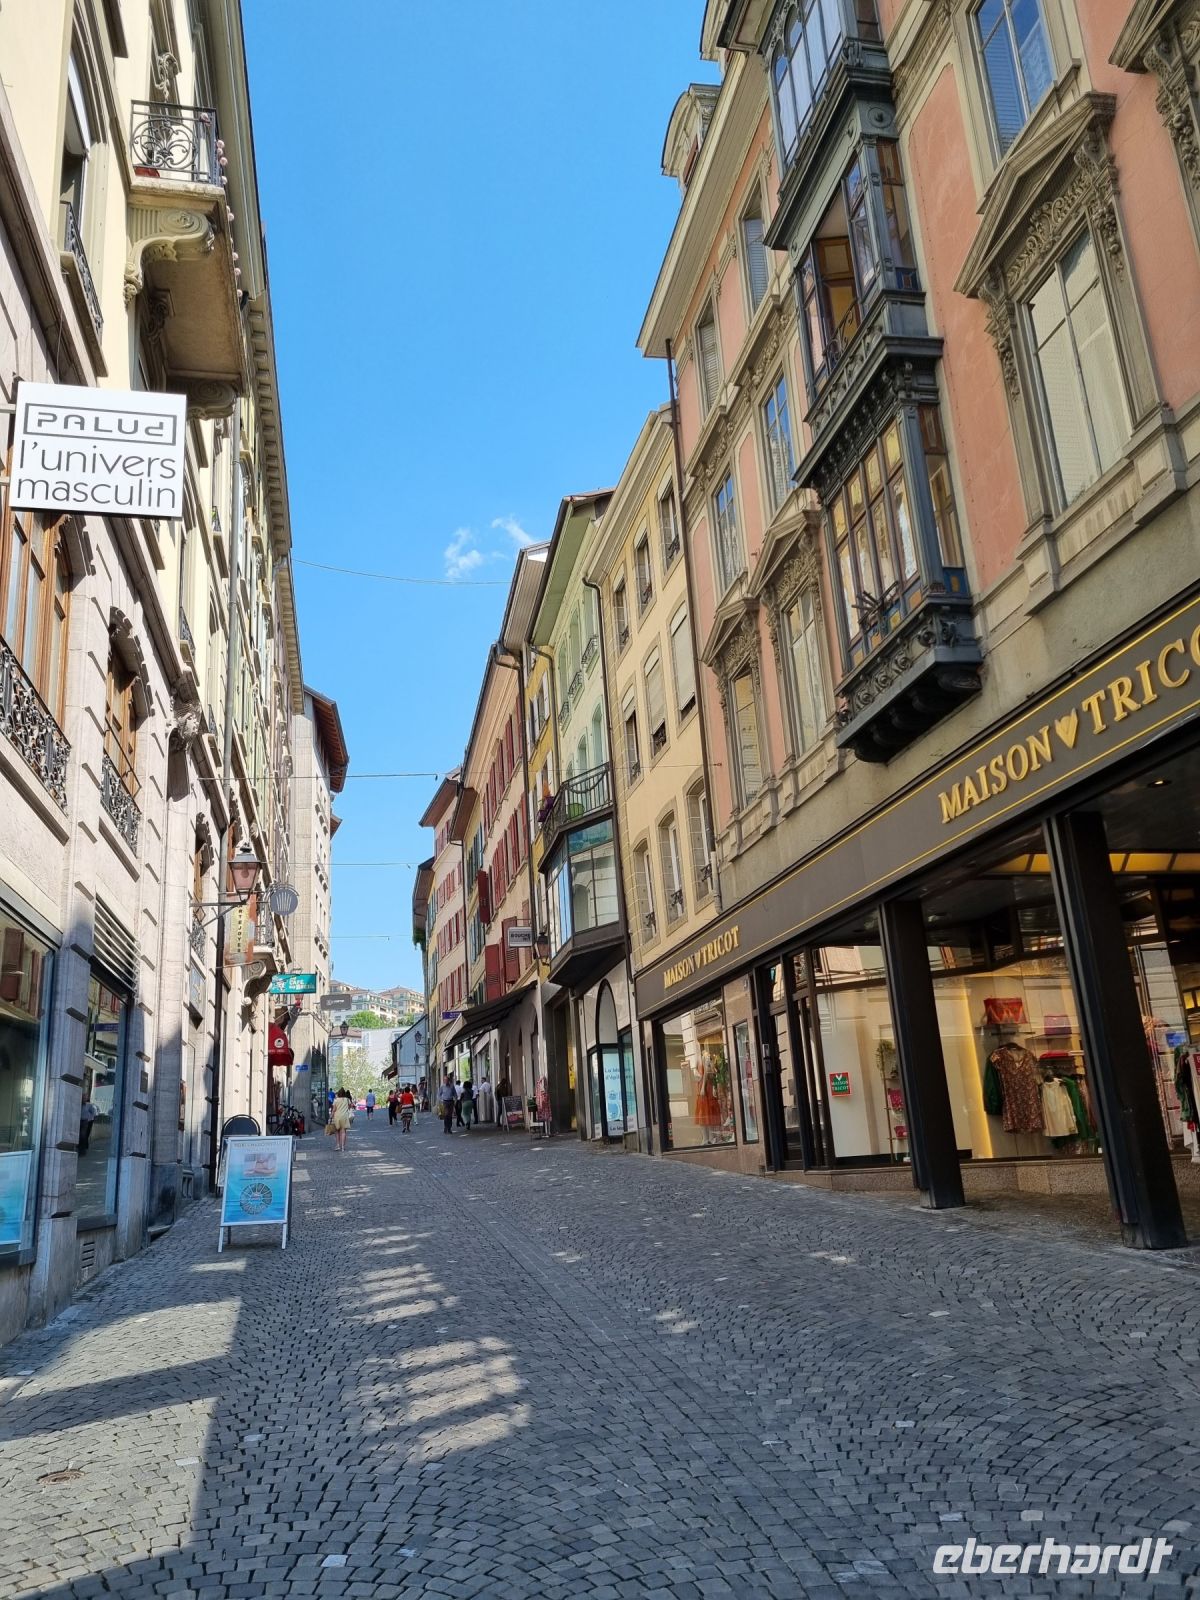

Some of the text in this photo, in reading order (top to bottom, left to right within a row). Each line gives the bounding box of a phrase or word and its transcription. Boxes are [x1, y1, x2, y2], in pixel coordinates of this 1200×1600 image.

[37, 411, 164, 437] PALUD
[17, 478, 176, 508] masculin
[938, 725, 1053, 824] MAISON
[663, 925, 739, 989] MAISON TRICOT
